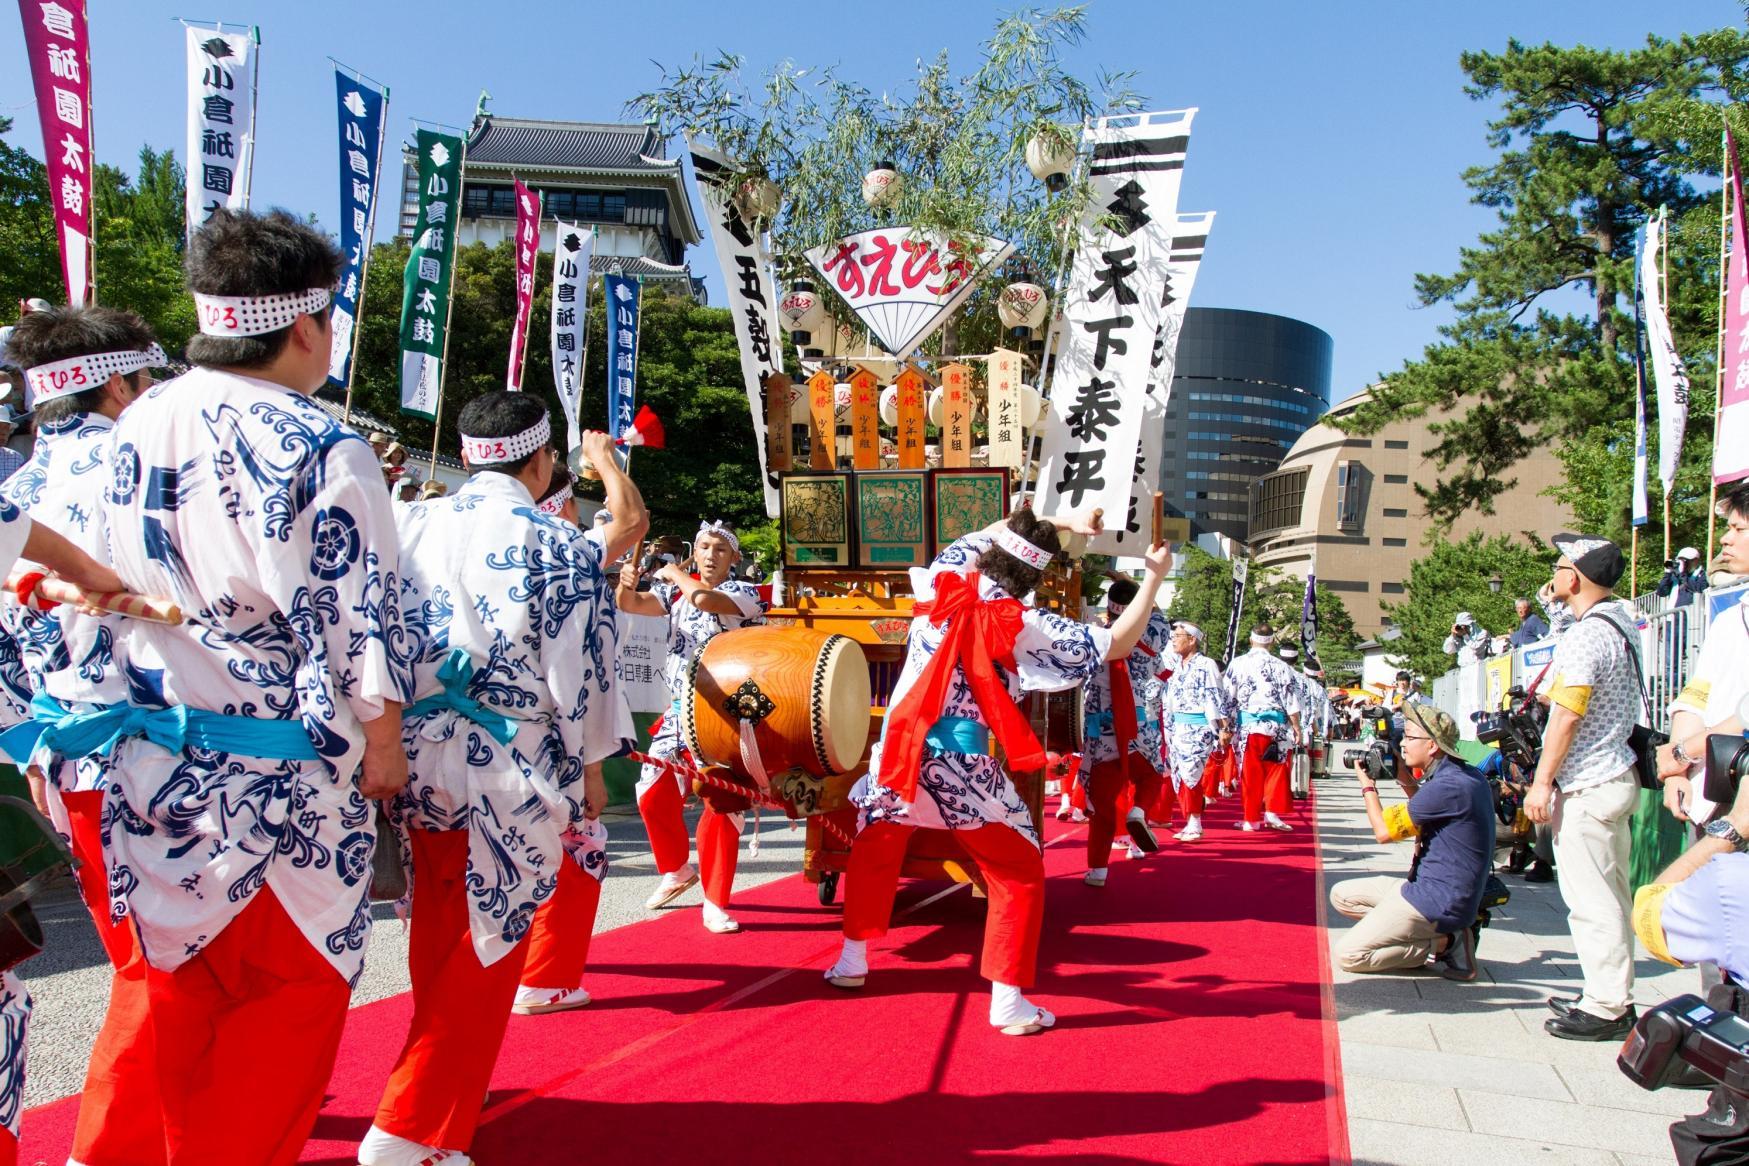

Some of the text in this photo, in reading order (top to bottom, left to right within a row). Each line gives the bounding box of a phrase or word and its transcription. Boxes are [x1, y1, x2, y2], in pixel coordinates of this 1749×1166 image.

[39, 2, 84, 216] 倉祇園太鼓
[412, 173, 449, 345] 小倉祇園太鼓
[823, 236, 987, 299] すえひろ
[199, 303, 238, 328] ひろ
[781, 295, 812, 312] すえひろ
[31, 365, 88, 396] えひろ
[734, 254, 779, 490] 五穀
[950, 373, 961, 400] 優勝
[1055, 245, 1139, 508] 天下泰平
[859, 415, 872, 449] 少年組
[905, 418, 917, 448] 少年組
[951, 411, 962, 451] 少年組
[998, 399, 1012, 443] 少年組
[623, 645, 651, 660] 株式会社
